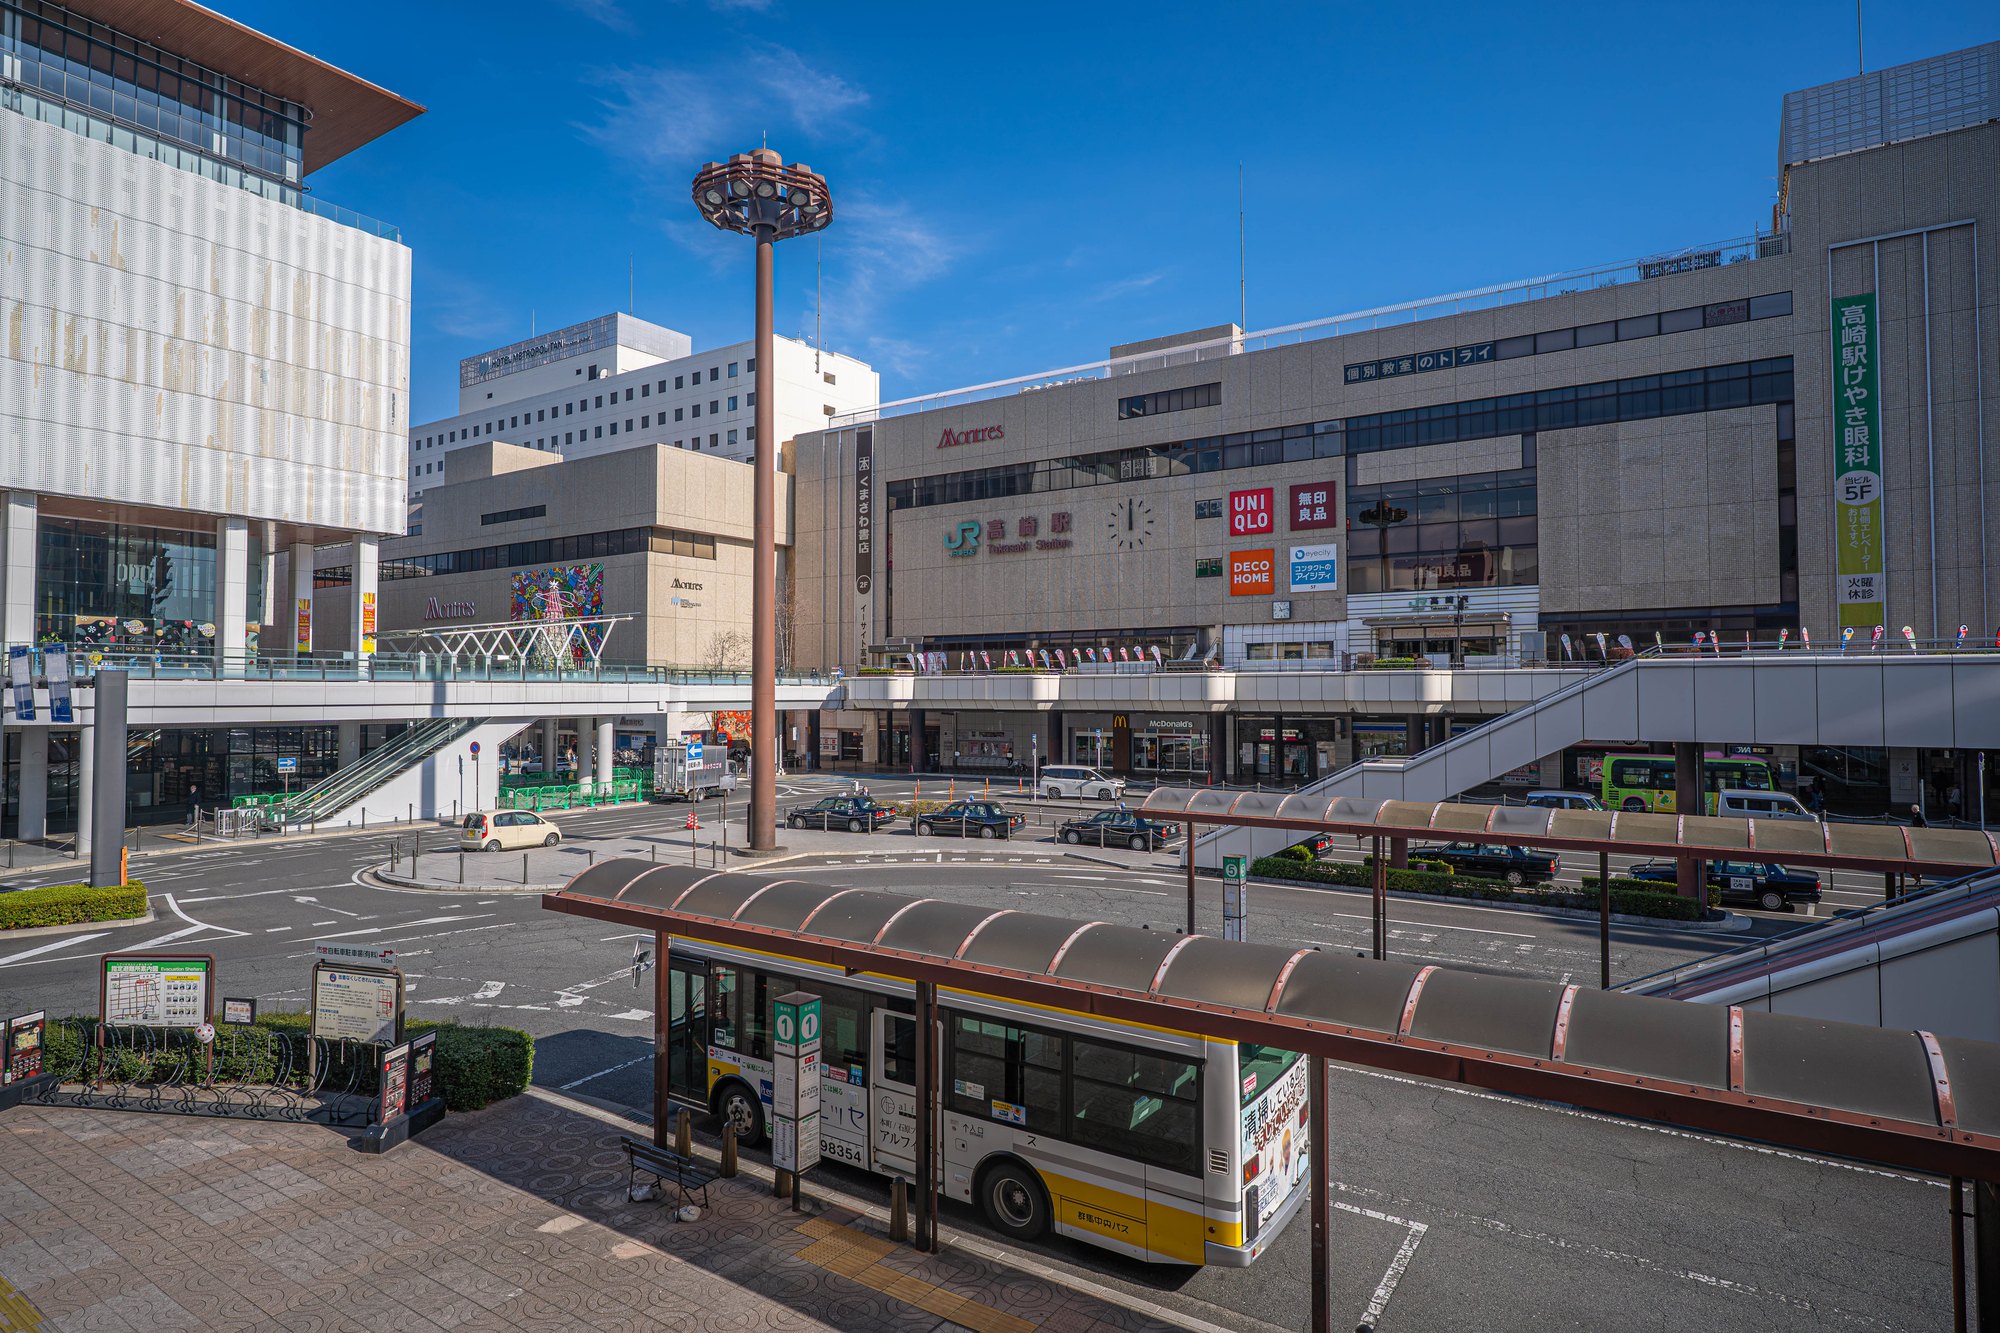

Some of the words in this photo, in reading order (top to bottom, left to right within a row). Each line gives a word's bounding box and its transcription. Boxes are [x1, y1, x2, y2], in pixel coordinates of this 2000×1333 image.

[491, 355, 512, 369] HOTEL
[512, 340, 564, 361] METROPOLITAN
[1347, 345, 1491, 381] 個別教室のトライ
[1840, 304, 1871, 468] 高崎駅けやき眼科
[936, 424, 1004, 449] Montres
[1844, 476, 1872, 485] 当ビル
[1298, 491, 1327, 506] 無印
[1845, 484, 1872, 501] 5F
[1234, 494, 1265, 511] UNI
[858, 475, 870, 555] くまざわ書店
[1234, 512, 1268, 532] QLO
[1298, 506, 1327, 522] 良品
[986, 511, 1071, 541] 高崎駅
[1848, 508, 1859, 549] おりてすぐ
[943, 521, 981, 549] JR
[1859, 507, 1871, 571] 南側エレベーター
[987, 540, 1030, 555] Takasaki
[1035, 538, 1072, 550] Station
[1305, 549, 1331, 558] eyecity
[1234, 561, 1270, 573] DECO
[1295, 564, 1332, 573] コンタクトの
[670, 577, 703, 591] Montres
[1234, 572, 1270, 584] HOME
[1295, 572, 1332, 581] アイシティ
[1848, 577, 1874, 588] 火曜
[1848, 588, 1874, 600] 休診
[423, 596, 475, 620] Montres
[1149, 720, 1193, 728] McDonald's
[1228, 865, 1236, 876] 5
[970, 1125, 984, 1134] 入口
[1027, 1135, 1037, 1147] ス
[821, 1140, 862, 1163] 98354
[1077, 1211, 1129, 1234] 群馬中央バス
